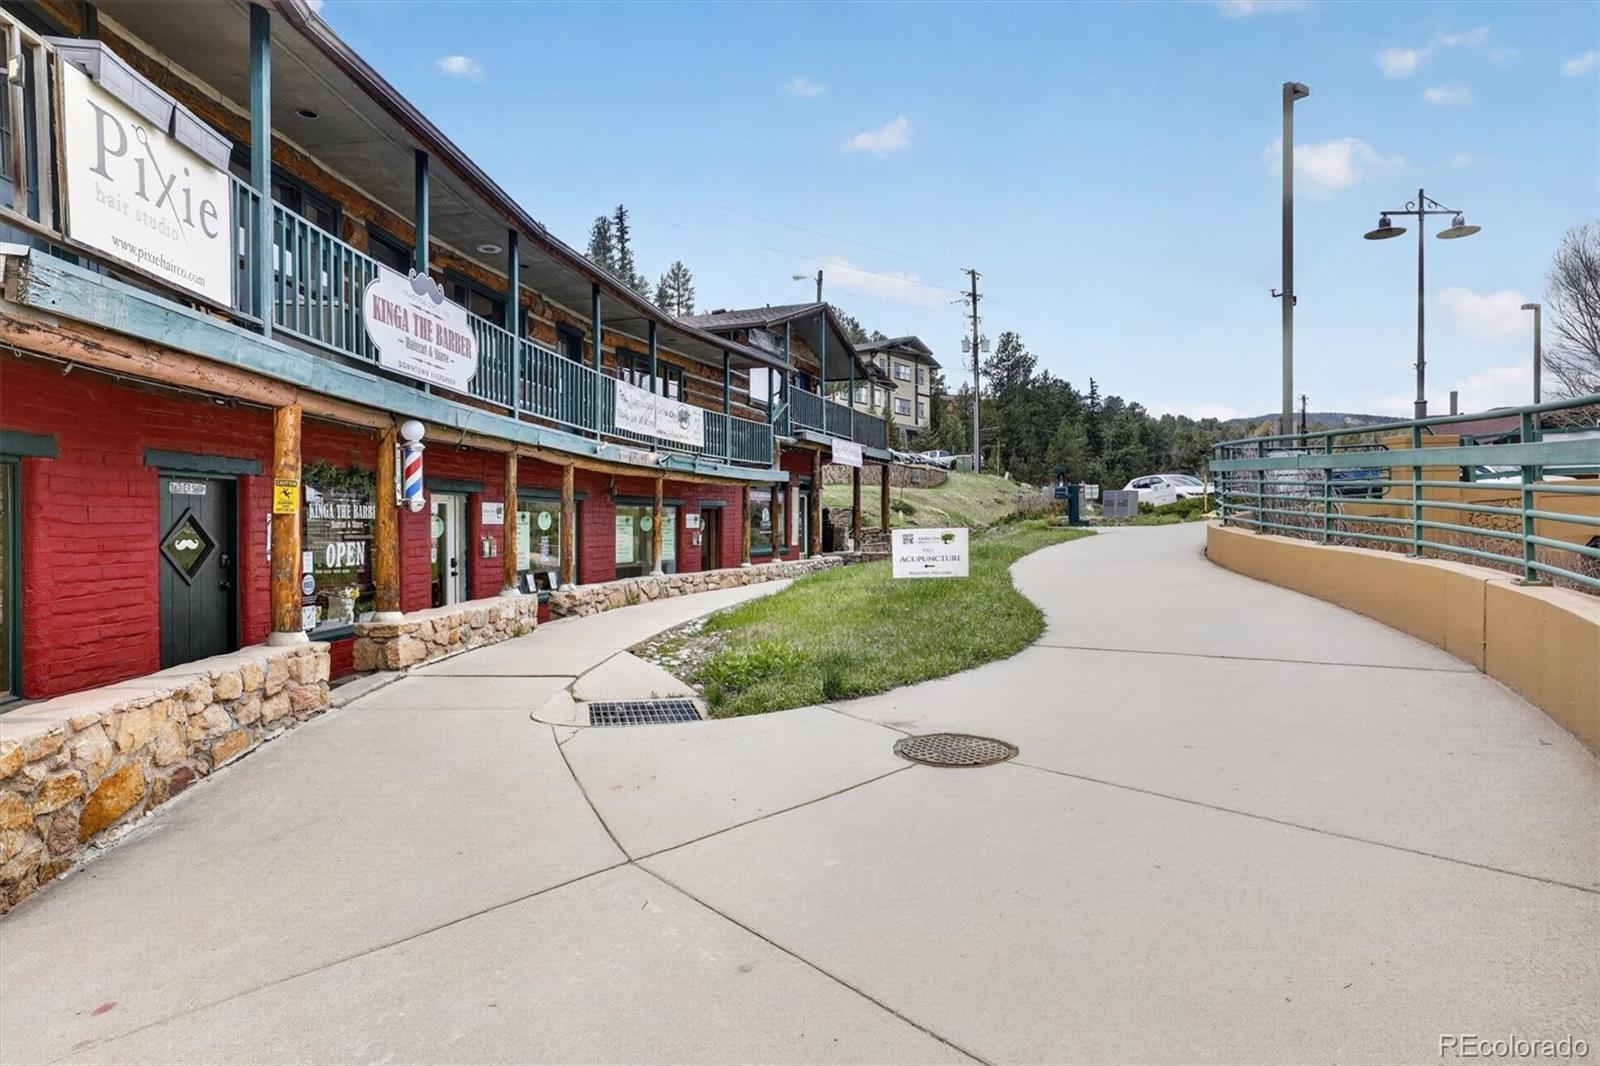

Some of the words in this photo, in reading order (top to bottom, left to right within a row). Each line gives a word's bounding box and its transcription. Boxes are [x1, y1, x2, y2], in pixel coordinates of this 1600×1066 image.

[87, 99, 218, 239] Pixie
[95, 182, 129, 215] hair
[135, 207, 179, 242] studio
[111, 235, 206, 287] www.pixiehairco.com
[372, 294, 409, 333] KINGA
[413, 312, 433, 342] THE
[435, 323, 472, 359] BARBER
[398, 359, 430, 377] DOWNTOWN
[309, 503, 334, 519] KINGA
[336, 504, 351, 519] THE
[353, 504, 376, 520] BARB
[326, 541, 365, 568] OPEN
[900, 555, 962, 563] ACUPUNCTURE
